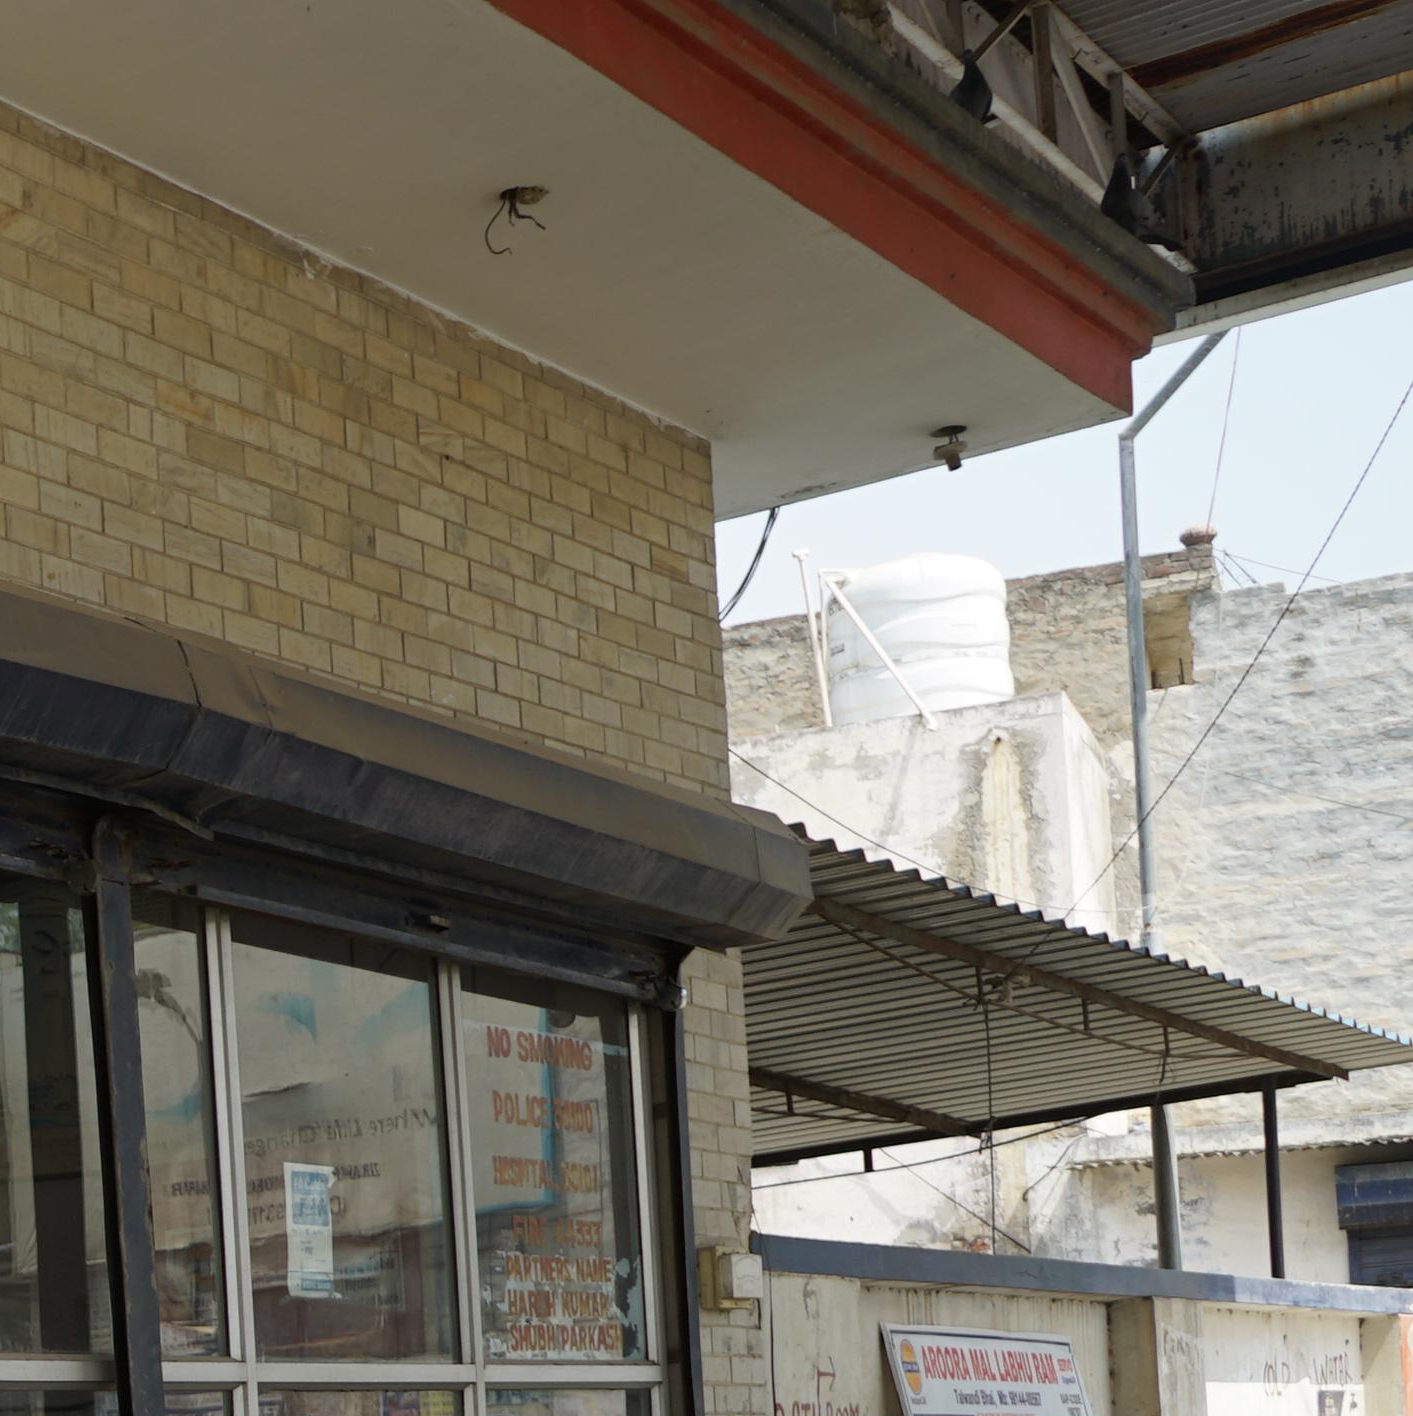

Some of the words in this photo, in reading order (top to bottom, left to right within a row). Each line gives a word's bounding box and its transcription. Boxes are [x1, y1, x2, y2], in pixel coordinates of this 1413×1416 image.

[486, 1025, 511, 1058] NO
[516, 1031, 593, 1072] SMOKING
[492, 1089, 549, 1128] POLICE
[576, 1257, 612, 1282] NAME
[562, 1290, 609, 1318] KUMAR
[921, 1345, 972, 1381] AROORA
[969, 1348, 997, 1382] MAL
[995, 1349, 1033, 1384] LABHU
[1031, 1353, 1059, 1384] RAM
